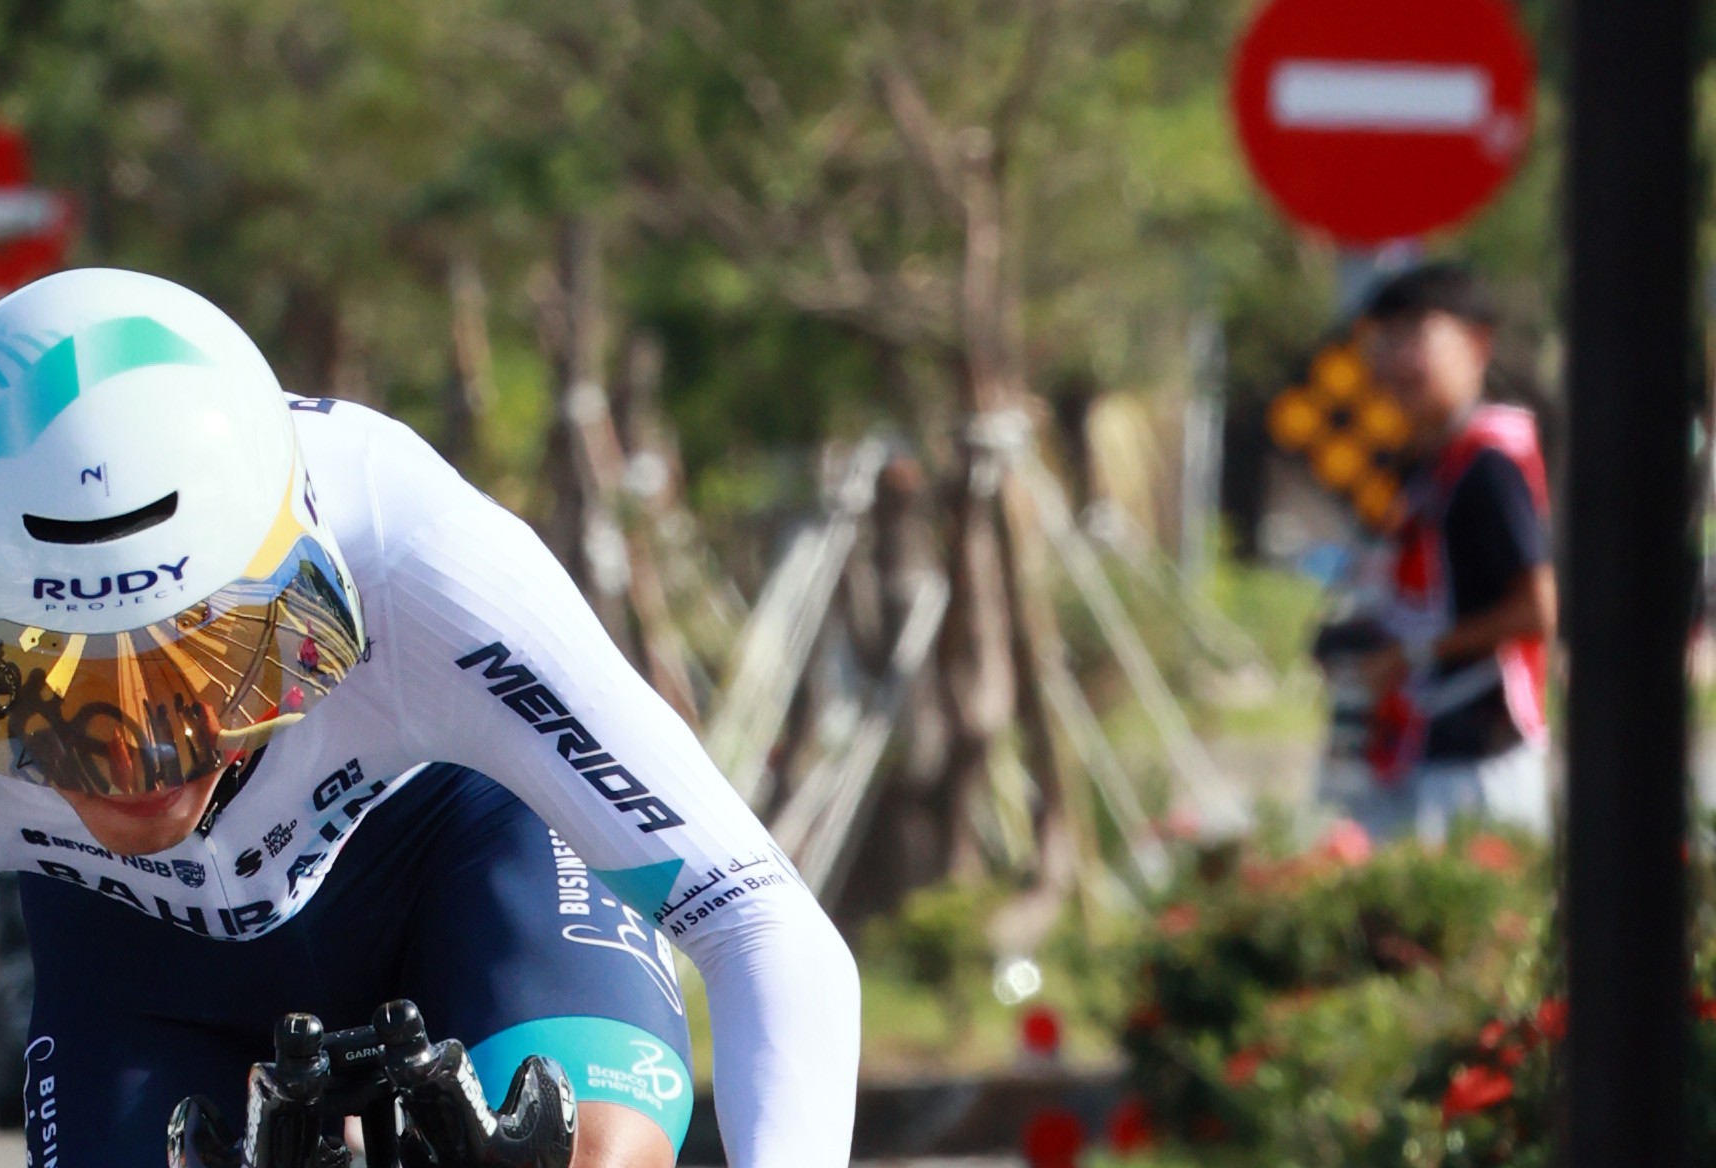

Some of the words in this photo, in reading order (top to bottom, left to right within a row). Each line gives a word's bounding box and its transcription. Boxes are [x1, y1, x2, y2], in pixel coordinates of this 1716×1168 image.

[33, 555, 190, 601] RUDY
[44, 584, 185, 612] PROJECT
[454, 640, 687, 834] MERIDA
[50, 835, 114, 861] BEYON
[120, 854, 173, 879] NBB
[669, 920, 688, 938] Al
[684, 886, 746, 926] Salam
